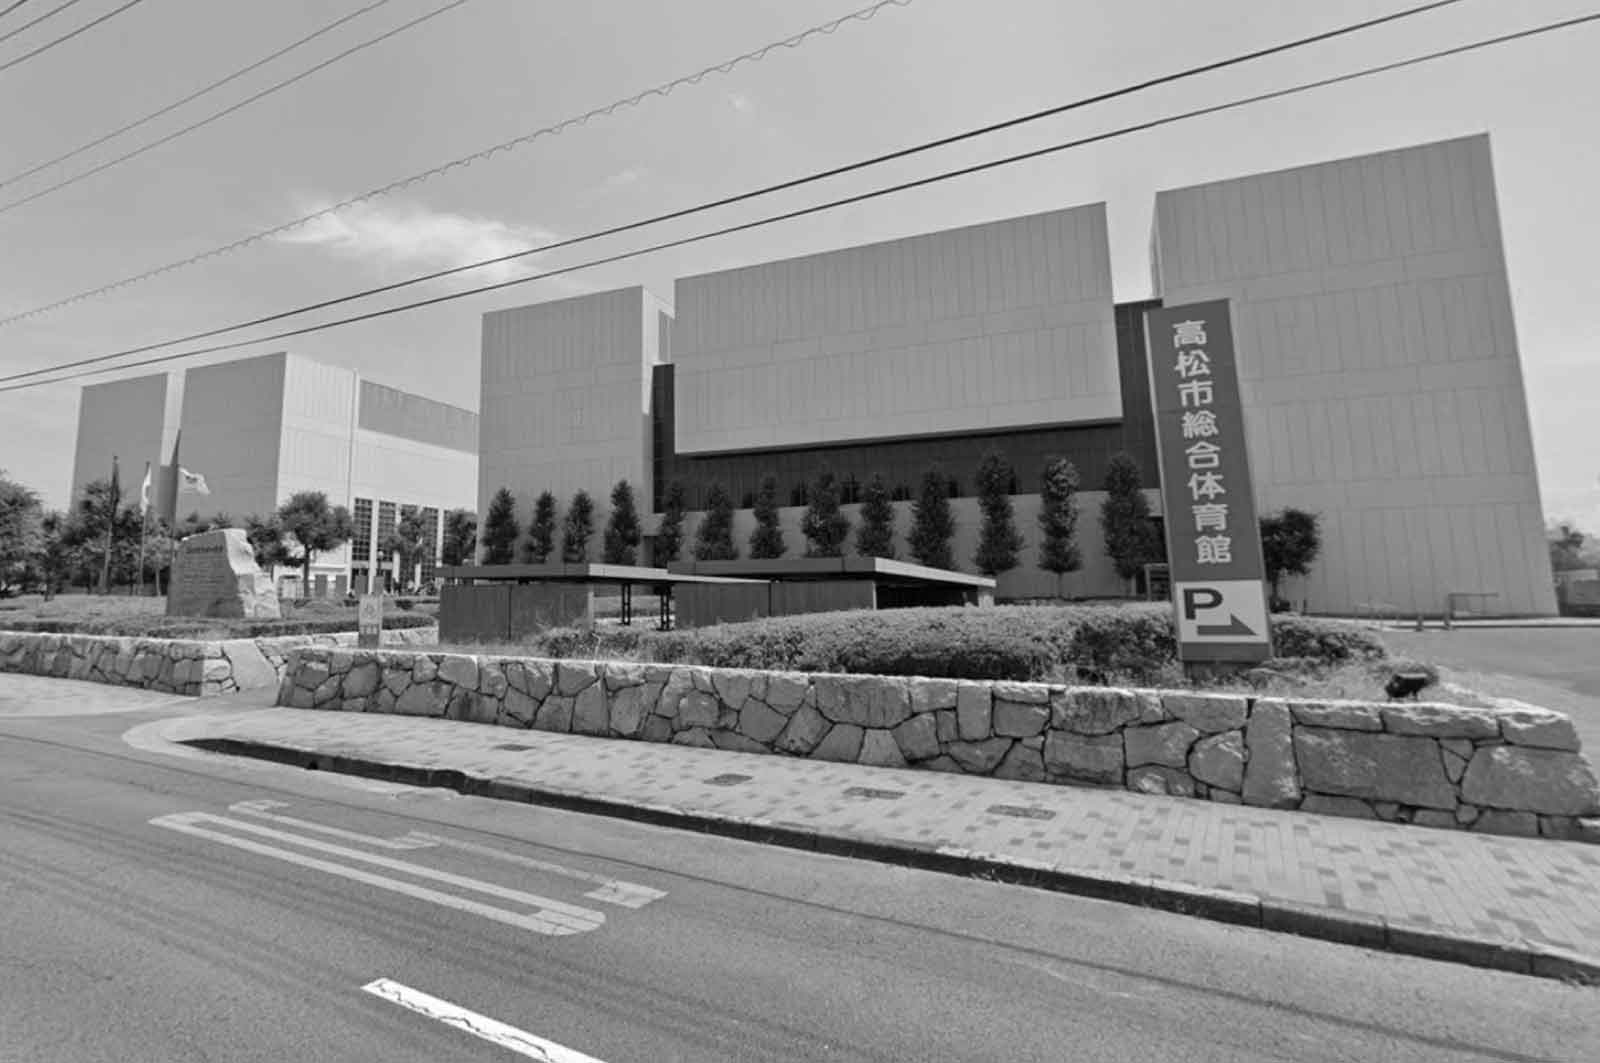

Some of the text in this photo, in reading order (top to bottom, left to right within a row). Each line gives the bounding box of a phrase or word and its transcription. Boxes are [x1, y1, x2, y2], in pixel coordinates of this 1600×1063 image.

[1172, 319, 1232, 564] 高松市総合体育館
[1183, 588, 1223, 620] P
